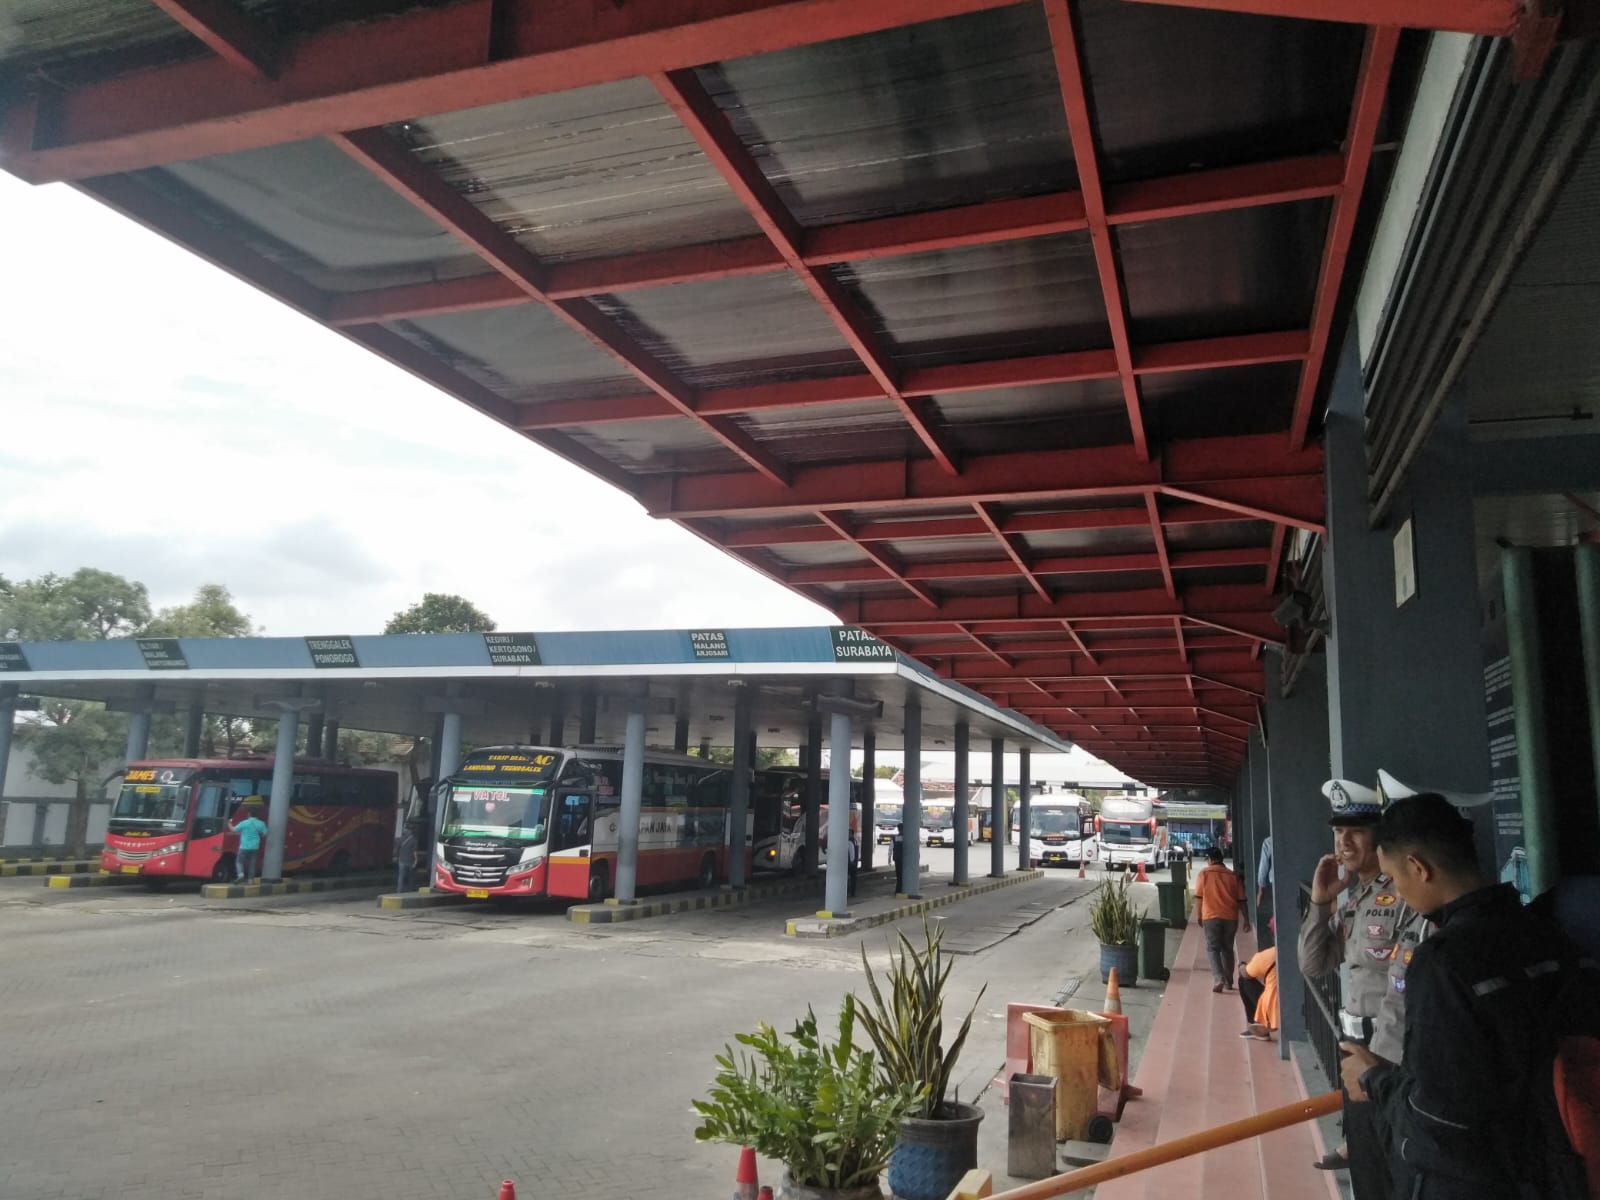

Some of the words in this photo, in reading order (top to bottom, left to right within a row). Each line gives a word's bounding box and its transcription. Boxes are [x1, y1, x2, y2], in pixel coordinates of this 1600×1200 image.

[691, 632, 725, 641] PATAS
[308, 639, 353, 650] TRENGGALEK
[488, 644, 533, 653] KERTOSONO
[835, 645, 893, 657] SURABAYA
[313, 652, 356, 664] PONOROGO
[491, 654, 531, 663] SURABAYA
